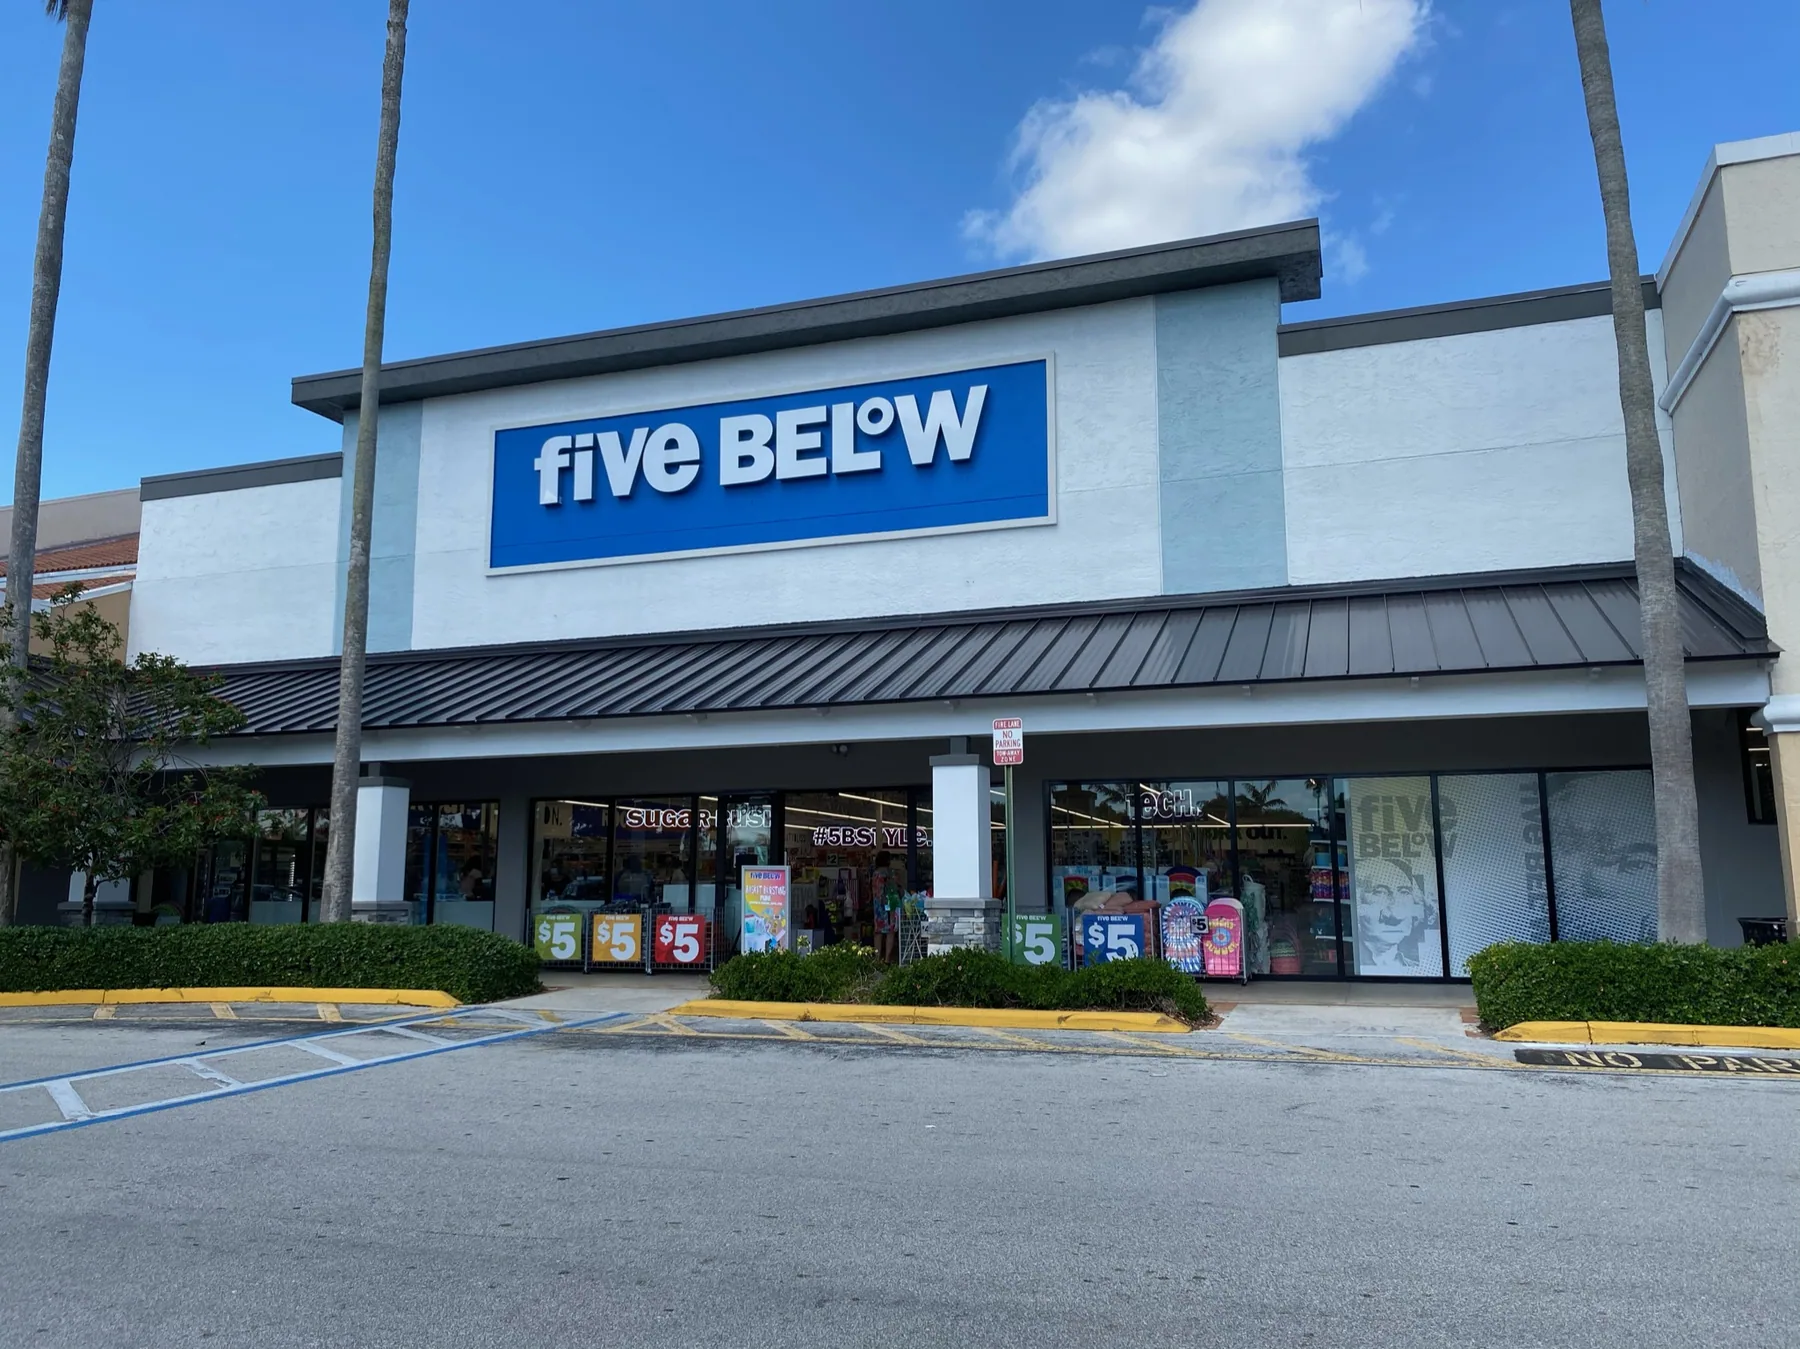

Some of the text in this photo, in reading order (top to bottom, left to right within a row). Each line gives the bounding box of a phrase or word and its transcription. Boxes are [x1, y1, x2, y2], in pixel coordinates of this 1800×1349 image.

[534, 422, 701, 506] five
[995, 720, 1020, 729] FIRE LANE
[1002, 730, 1013, 739] NO
[995, 739, 1021, 748] PARKING
[1192, 918, 1207, 931] $5
[538, 921, 576, 960] $5
[597, 921, 636, 961] $5
[659, 922, 700, 963] $5
[1088, 922, 1139, 962] $5
[1564, 1051, 1800, 1073] NO PAR
